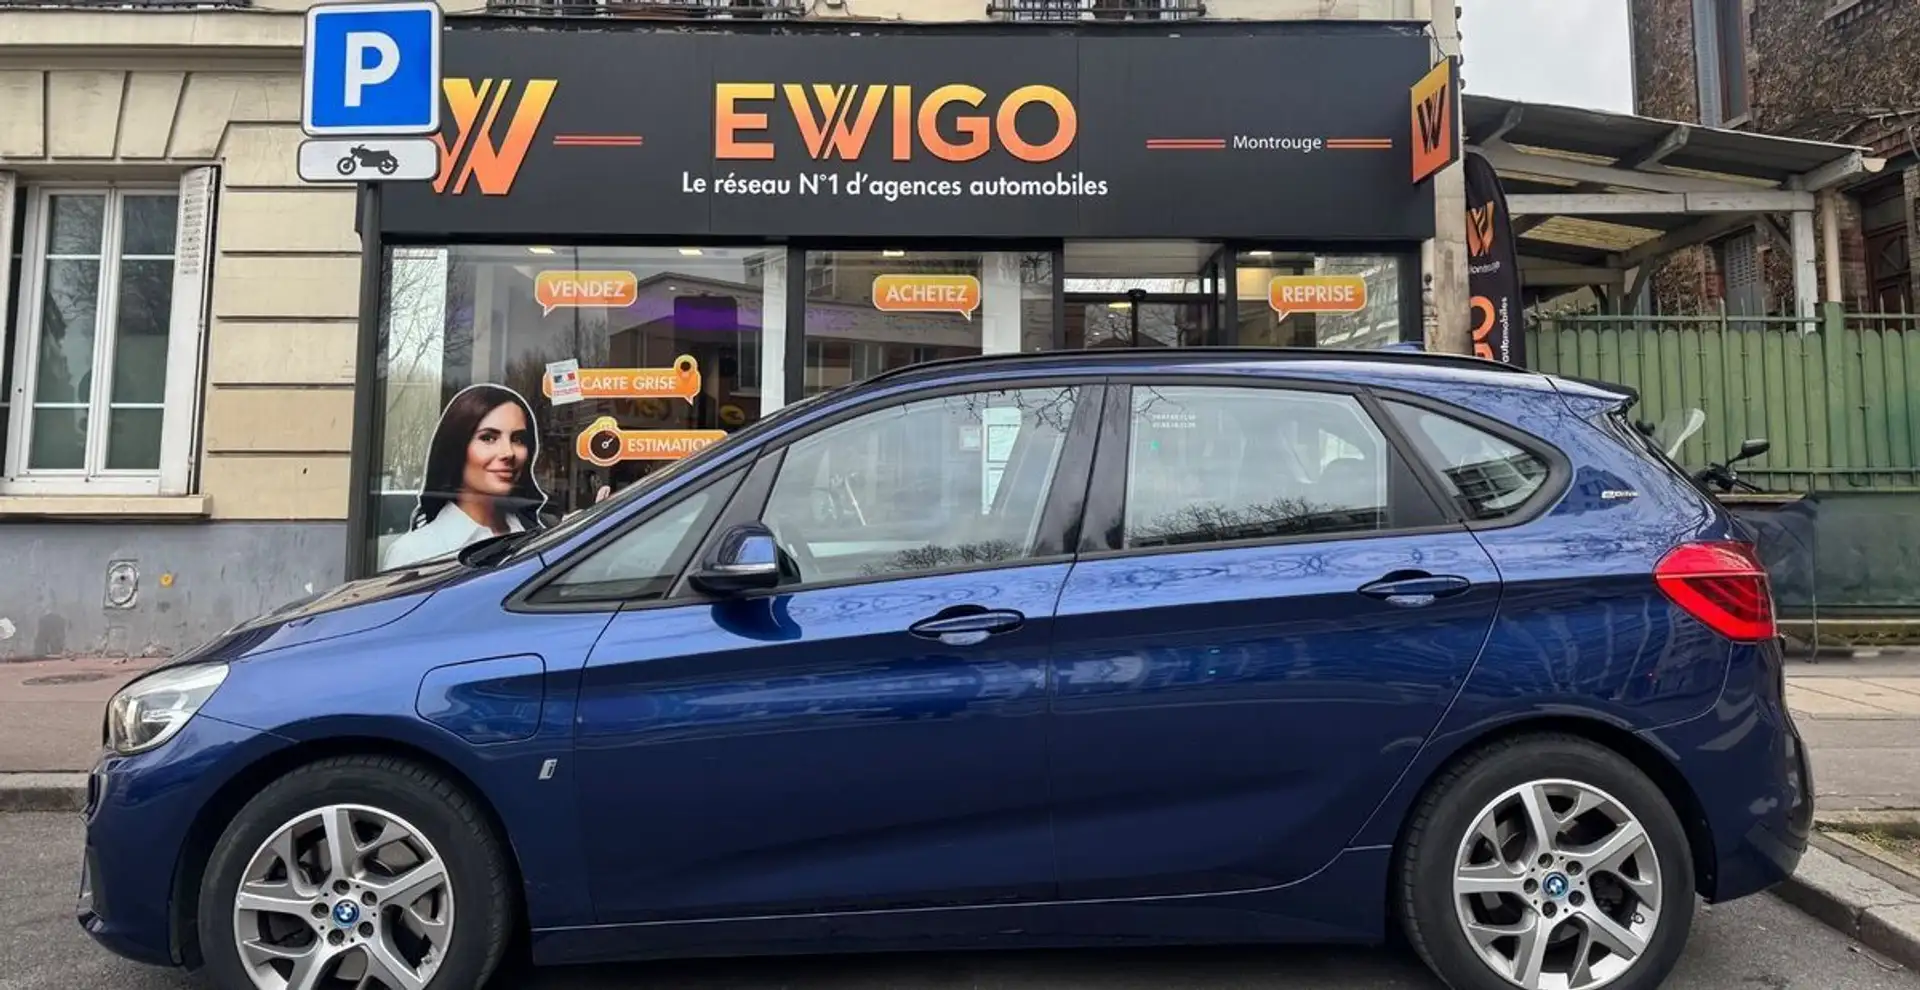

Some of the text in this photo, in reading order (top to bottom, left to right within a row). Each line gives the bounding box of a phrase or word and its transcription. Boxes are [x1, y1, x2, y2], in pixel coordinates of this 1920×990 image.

[344, 31, 401, 108] P
[715, 83, 1078, 162] EWIGO
[1233, 135, 1322, 153] Montrouge
[682, 172, 707, 194] Le
[714, 171, 791, 195] réseau
[969, 174, 1109, 196] automobiles
[548, 280, 626, 297] VENDEZ
[886, 284, 968, 302] ACHETEZ
[1281, 285, 1356, 303] REPRISE
[581, 376, 677, 390] CARTE GRISE
